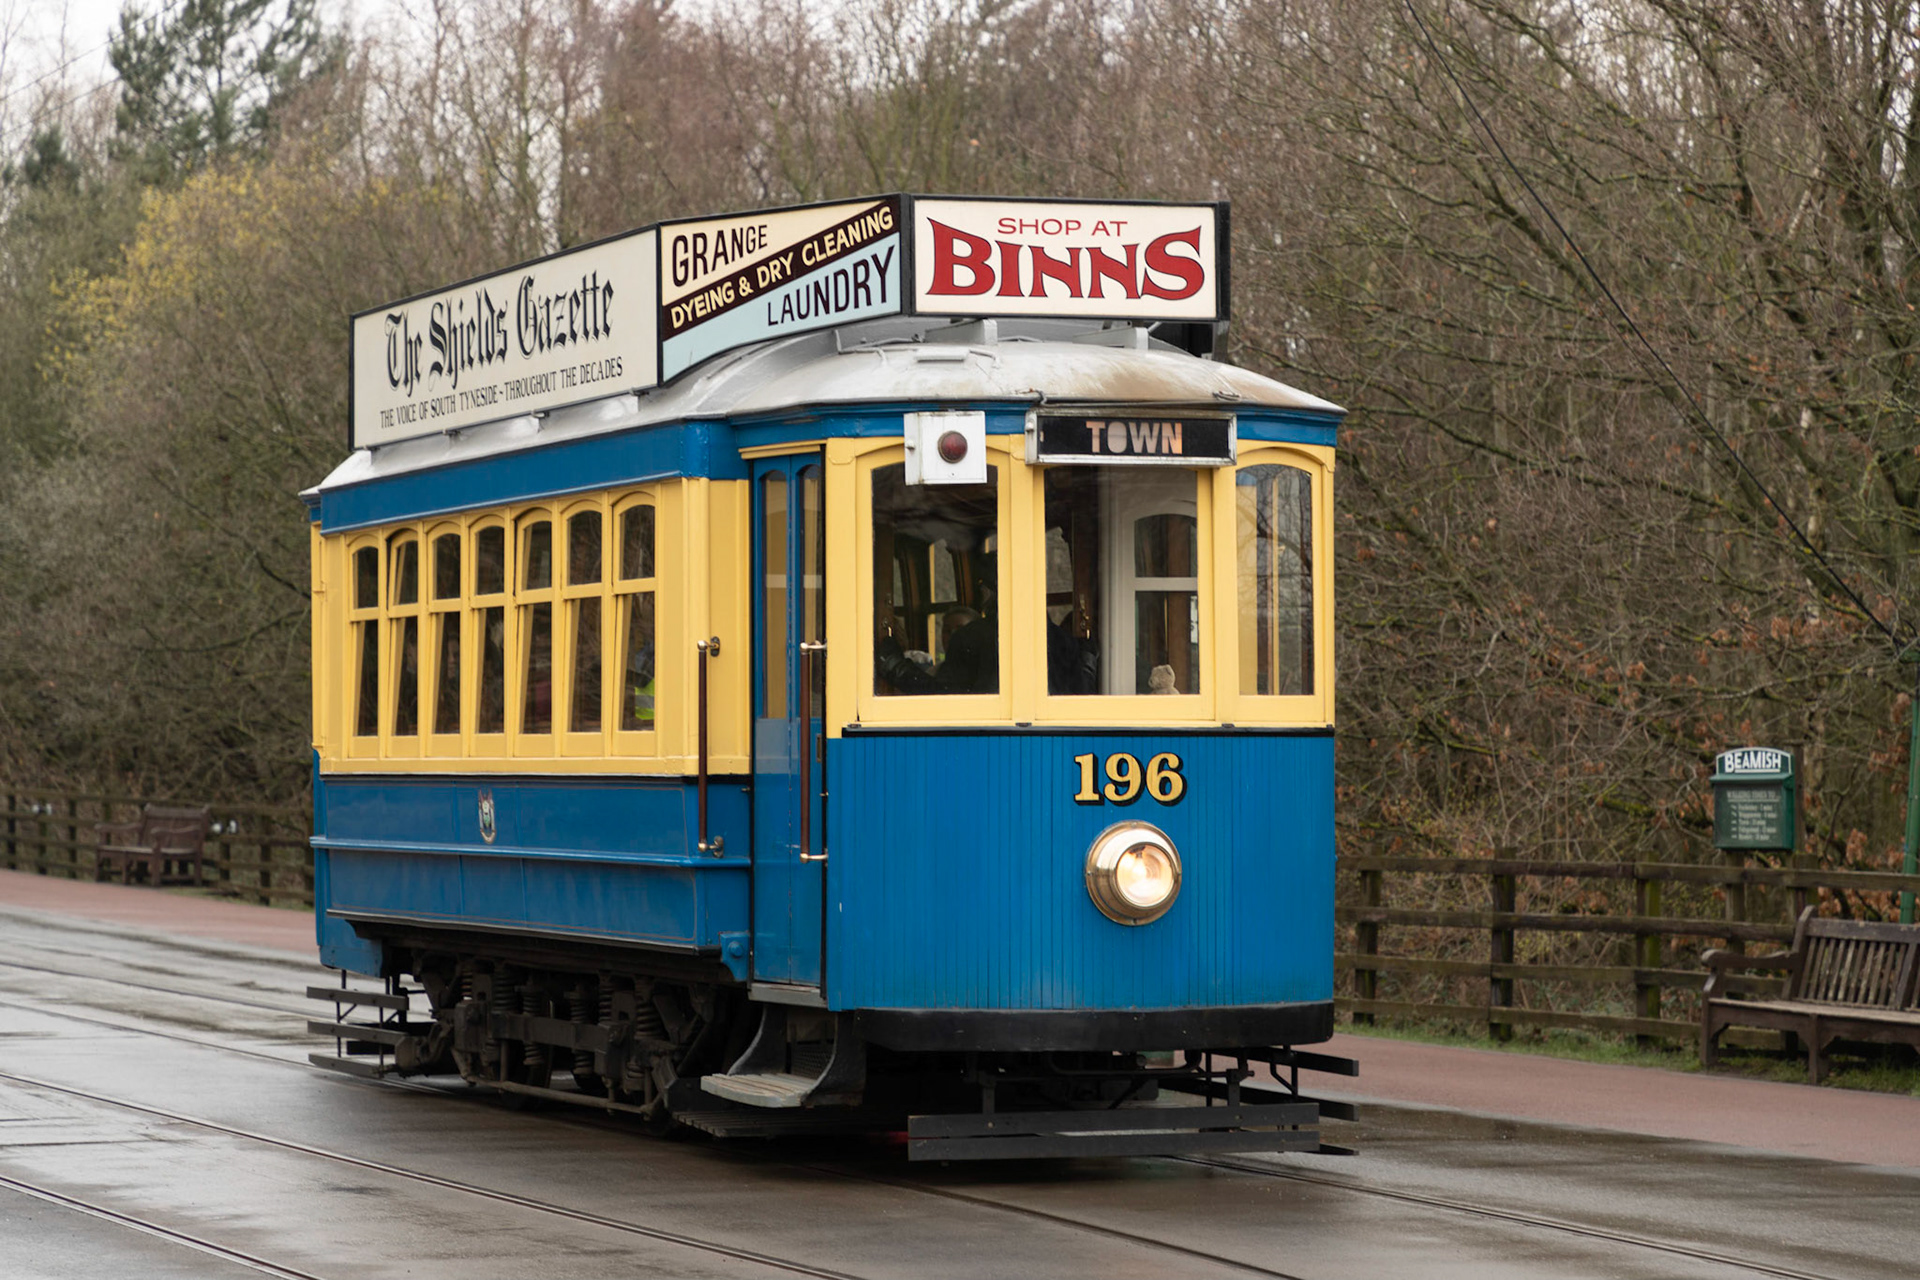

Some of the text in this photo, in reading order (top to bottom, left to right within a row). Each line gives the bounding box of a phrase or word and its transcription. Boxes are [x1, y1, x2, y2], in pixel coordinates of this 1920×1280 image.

[672, 224, 768, 288] GRANGE
[925, 216, 1205, 301] BINNS
[997, 217, 1128, 237] SHOP AT
[670, 206, 894, 329] DYEING & DRY CLEANING
[767, 244, 896, 326] LAUNDRY
[384, 270, 614, 398] The Shields Gazette
[380, 409, 394, 428] THE
[396, 404, 416, 425] VOICE
[419, 401, 429, 420] OF
[430, 394, 456, 418] SOUTH
[459, 385, 498, 411] TYNESIDE
[504, 371, 557, 401] THROUGHOUT
[560, 366, 577, 389] THE
[580, 356, 623, 385] DECADES
[1086, 421, 1183, 455] TOWN
[1073, 752, 1188, 807] 196
[1724, 750, 1781, 773] BEAMISH
